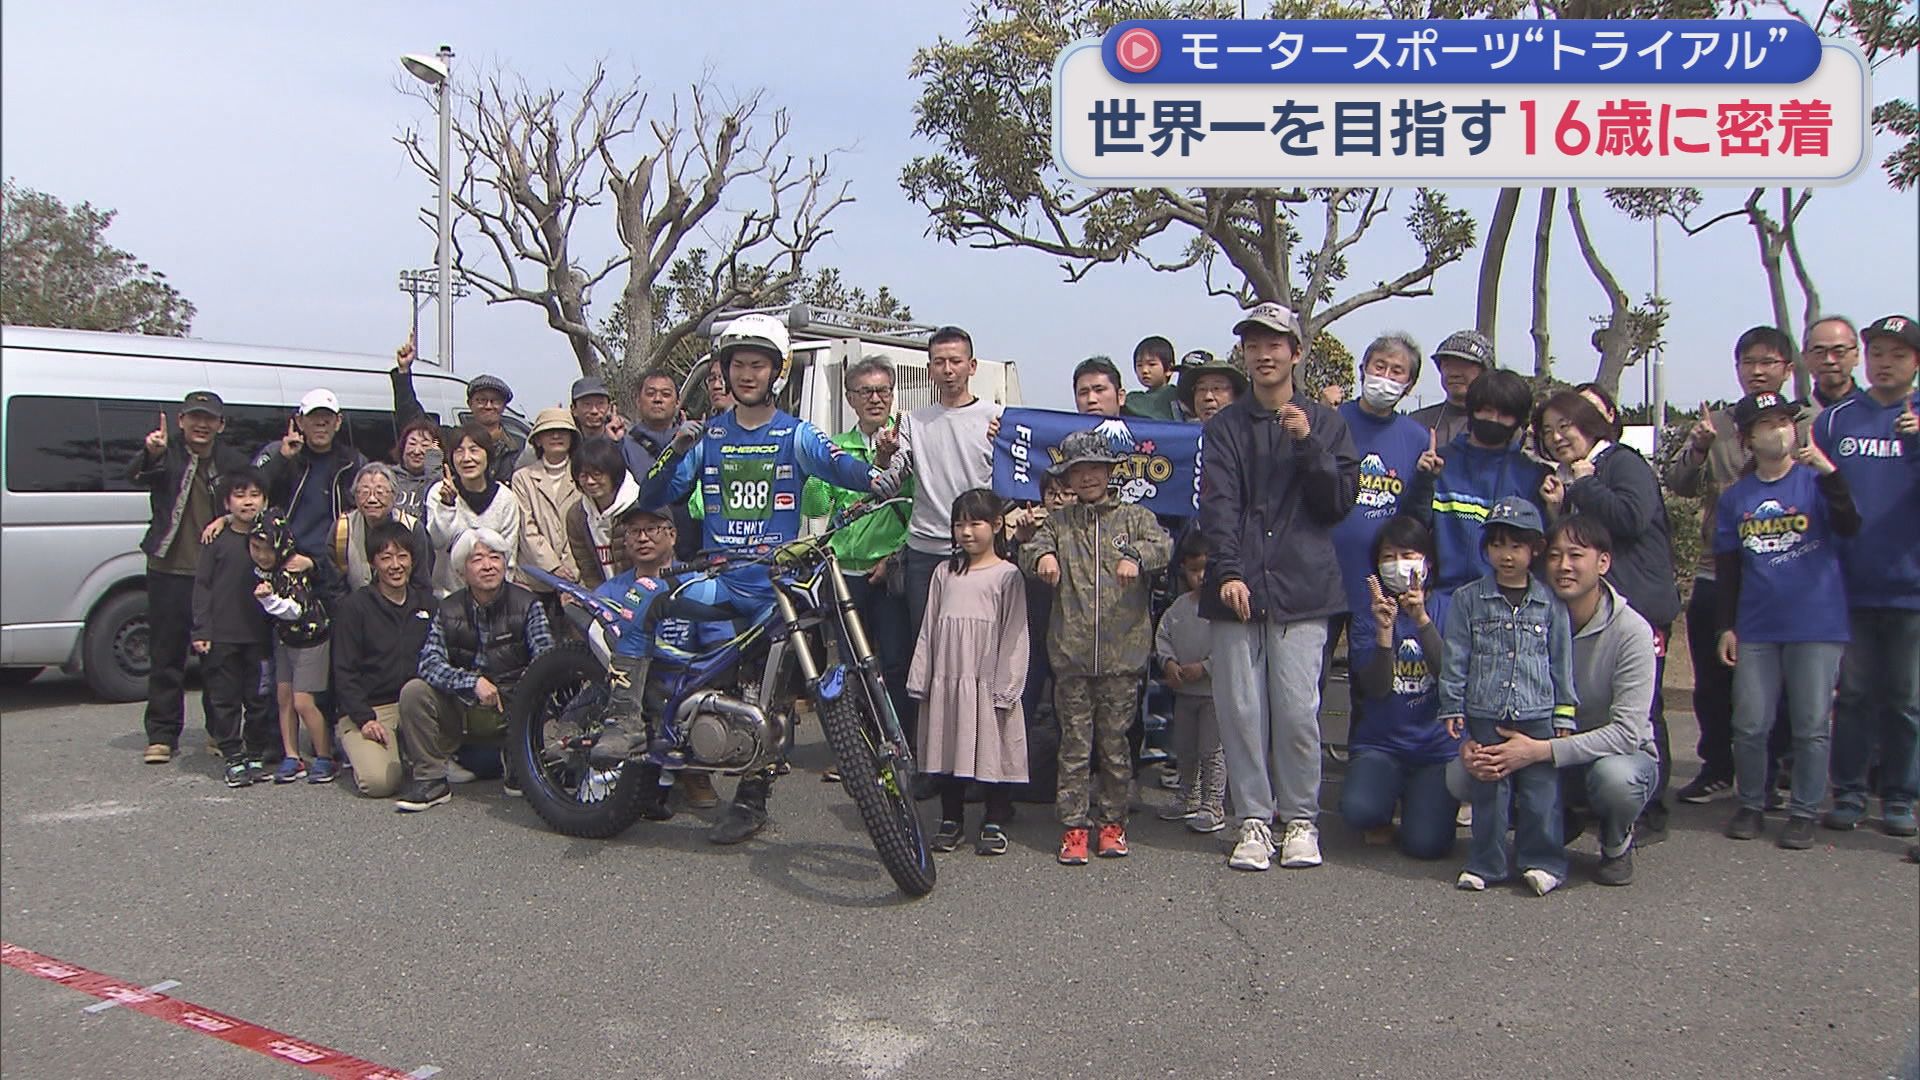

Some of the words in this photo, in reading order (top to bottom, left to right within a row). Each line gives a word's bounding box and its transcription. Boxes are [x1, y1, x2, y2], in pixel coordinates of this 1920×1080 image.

[720, 444, 780, 454] SHERCO
[1010, 424, 1032, 484] Fight
[730, 480, 769, 509] 388
[727, 520, 765, 535] KENNY
[1738, 514, 1809, 538] YAMATO
